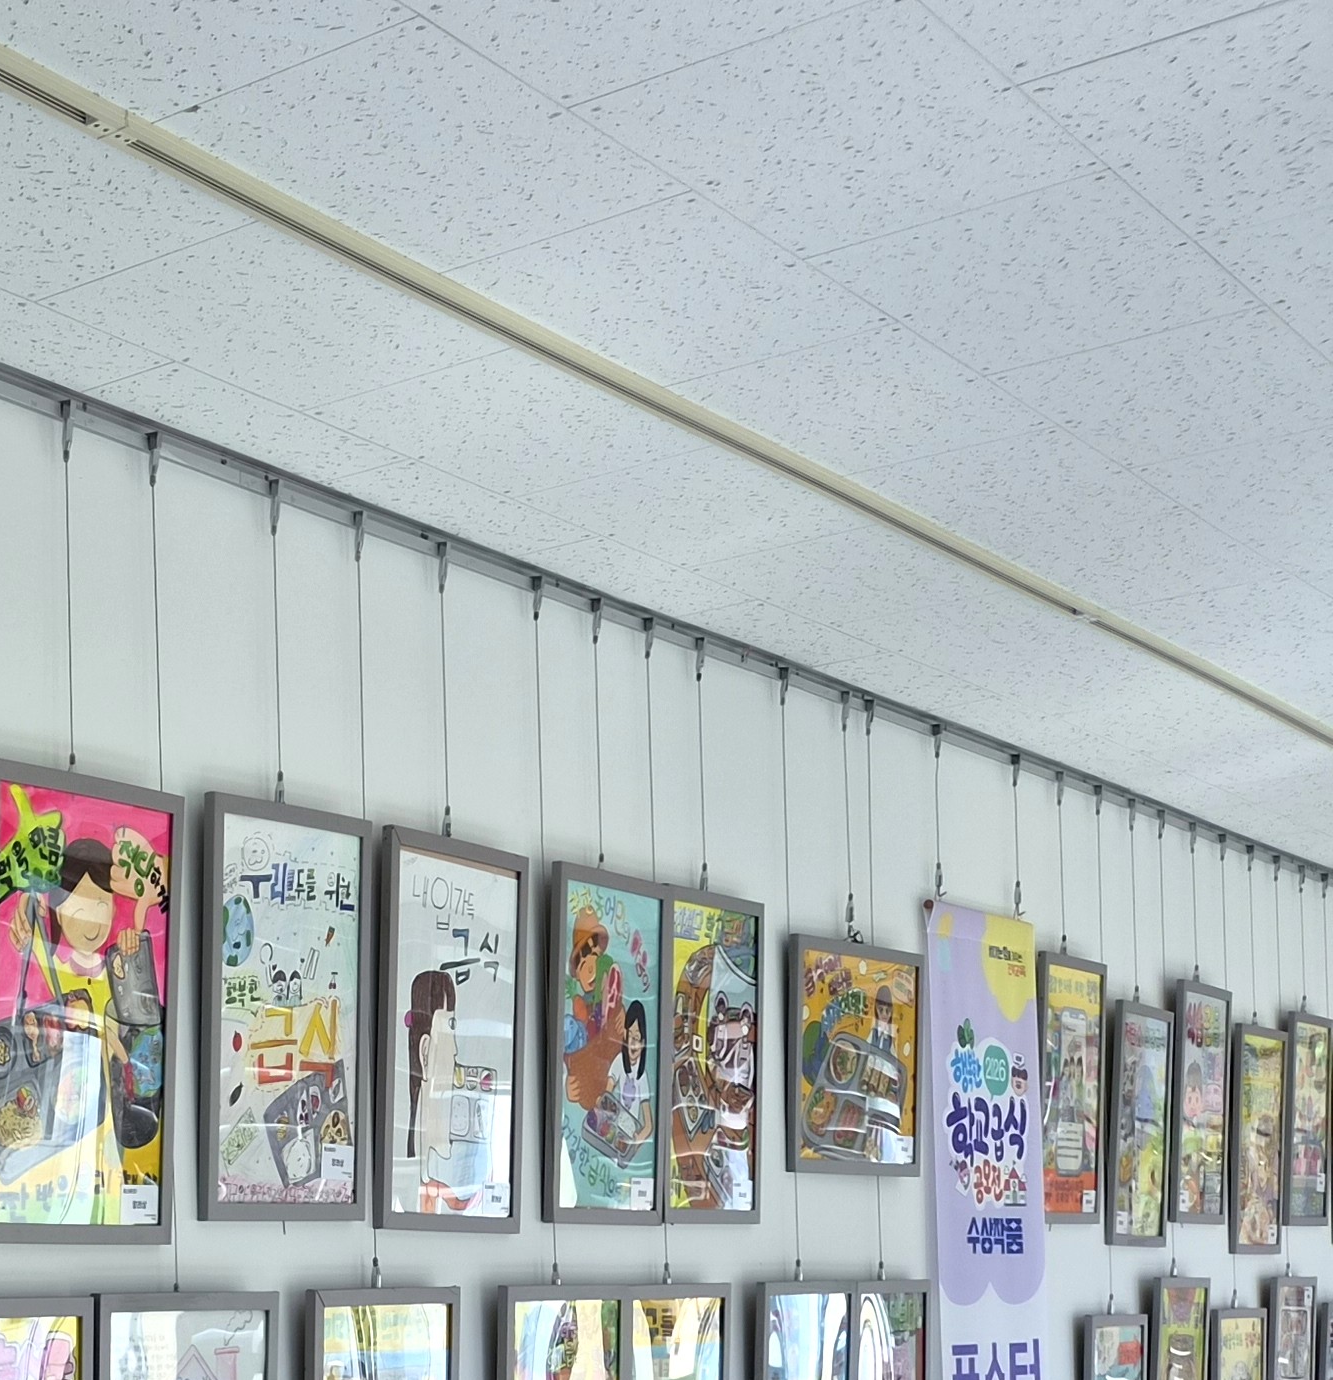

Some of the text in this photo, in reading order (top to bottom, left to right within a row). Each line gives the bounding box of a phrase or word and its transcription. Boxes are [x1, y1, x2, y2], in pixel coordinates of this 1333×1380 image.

[439, 928, 501, 986] 급식
[950, 1048, 983, 1094] 행복한
[984, 1055, 1008, 1082] 2026
[973, 1158, 1004, 1205] 공모전
[966, 1216, 1024, 1255] 수상작품
